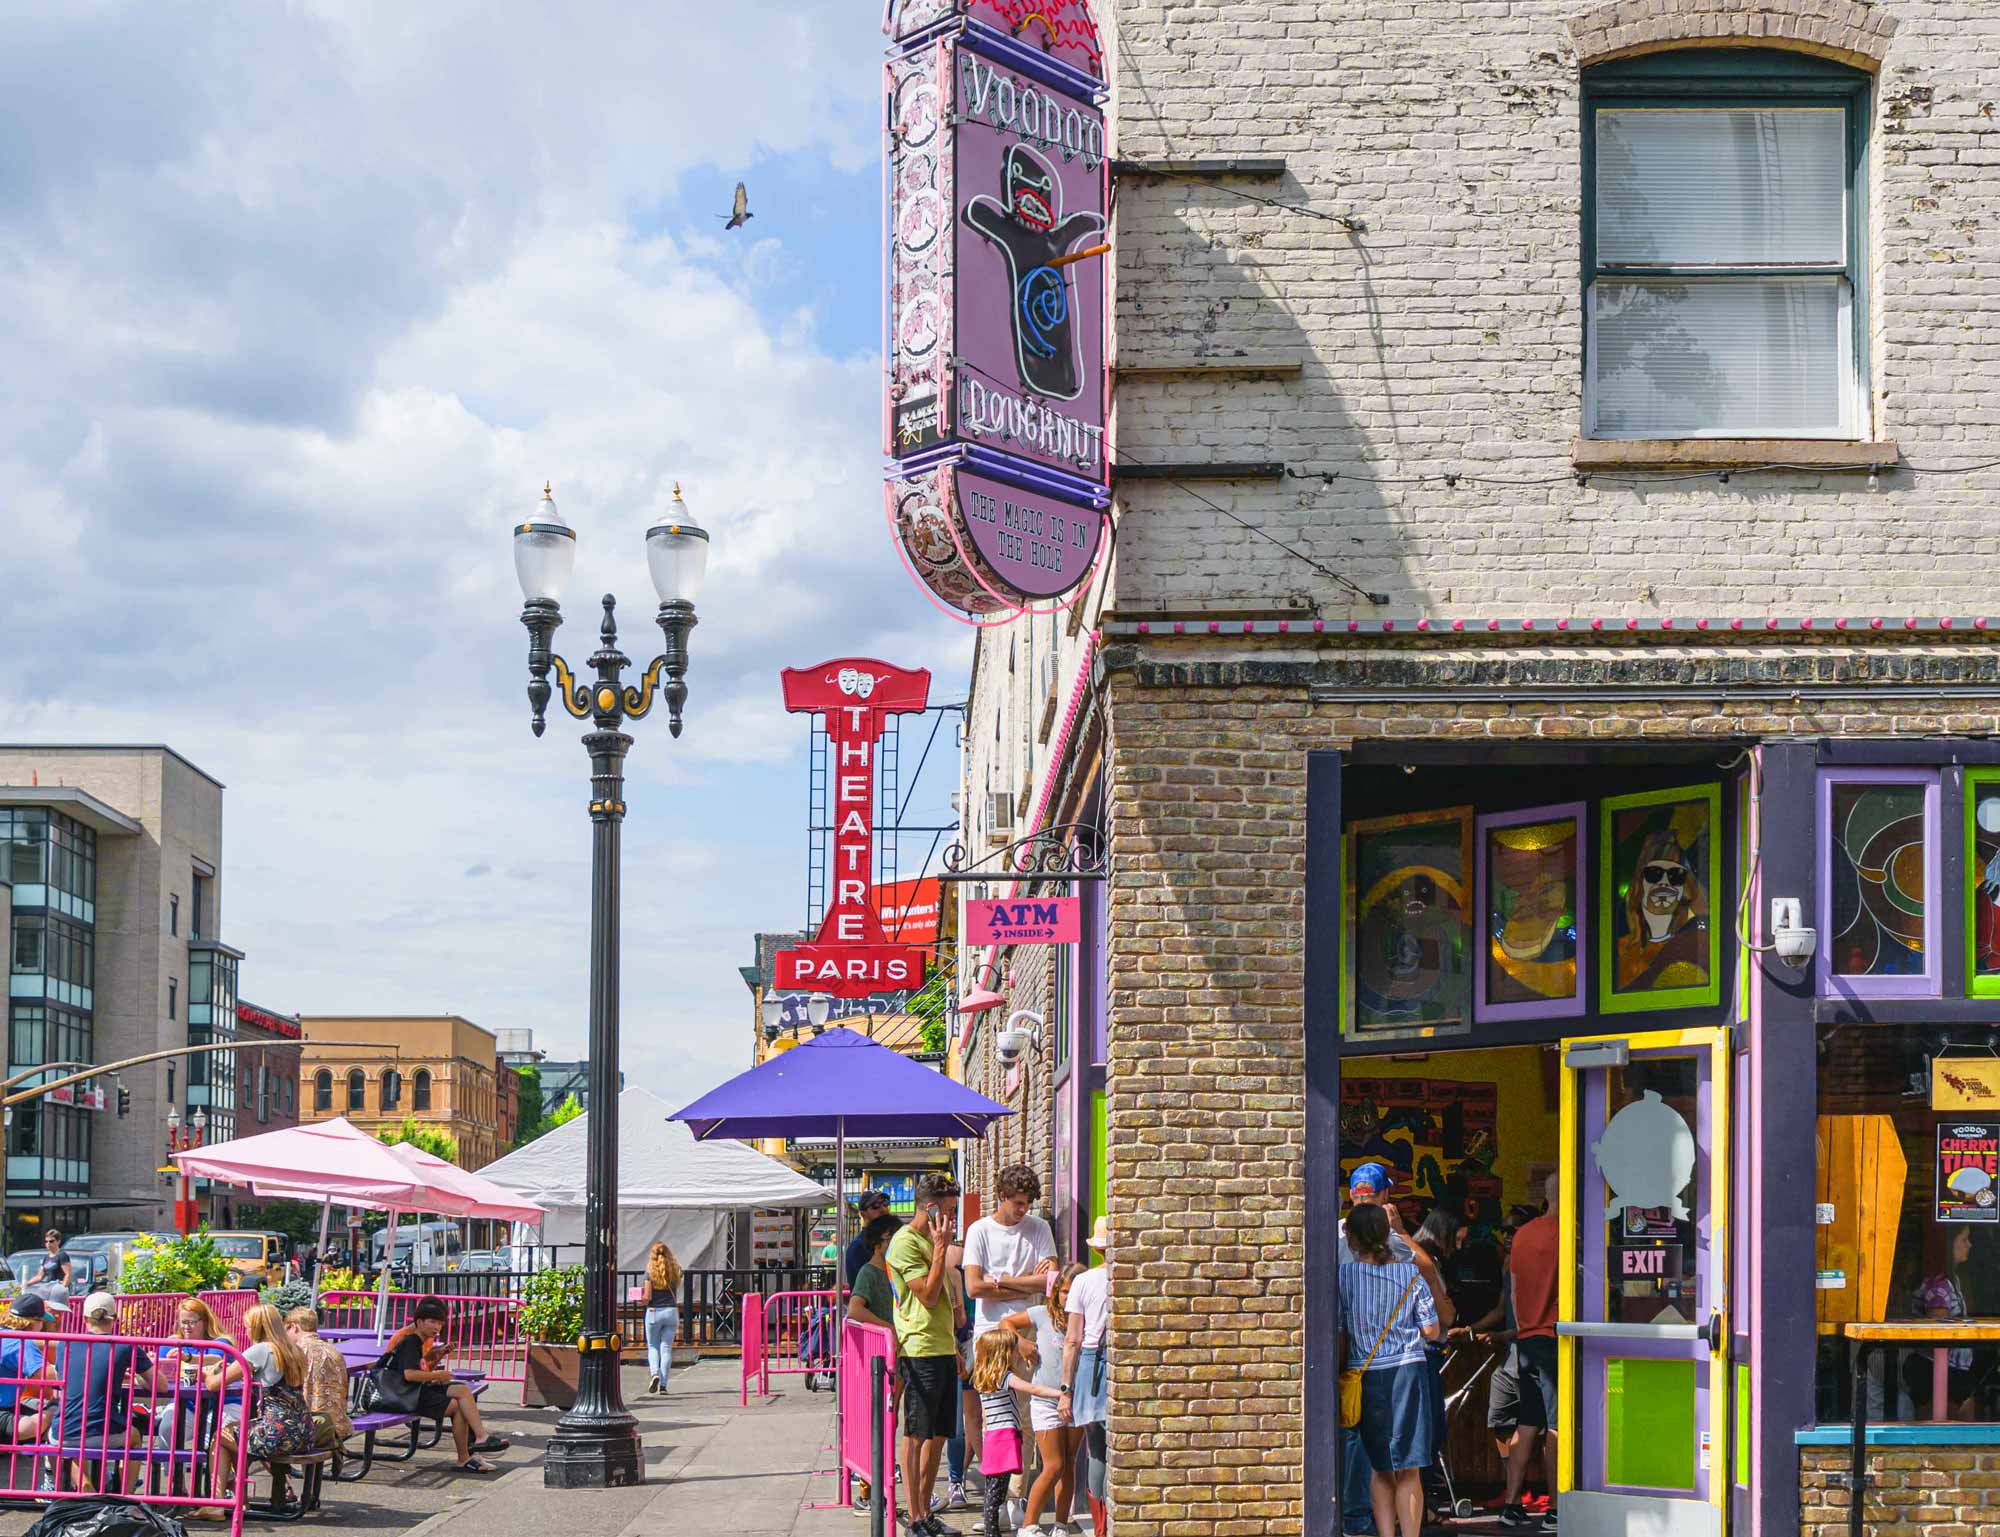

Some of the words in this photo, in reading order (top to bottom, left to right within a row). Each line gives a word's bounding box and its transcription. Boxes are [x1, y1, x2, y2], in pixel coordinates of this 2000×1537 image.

[960, 53, 1105, 173] VOODOO
[960, 373, 1105, 470] DOUGHNUT
[970, 491, 996, 524] THE
[1003, 502, 1044, 537] MAGIC
[1050, 516, 1065, 544] IS
[1072, 522, 1088, 550] IN
[997, 531, 1023, 562] THE
[1030, 541, 1063, 574] HOLE
[838, 706, 869, 941] THEATRE
[988, 903, 1059, 927] ATM
[1004, 928, 1044, 938] INSIDE
[795, 959, 909, 980] PARIS
[1952, 1126, 1987, 1135] VOODOO
[1941, 1138, 1998, 1151] CHERRY
[1941, 1154, 1998, 1174] TIME
[1622, 1250, 1666, 1274] EXIT
